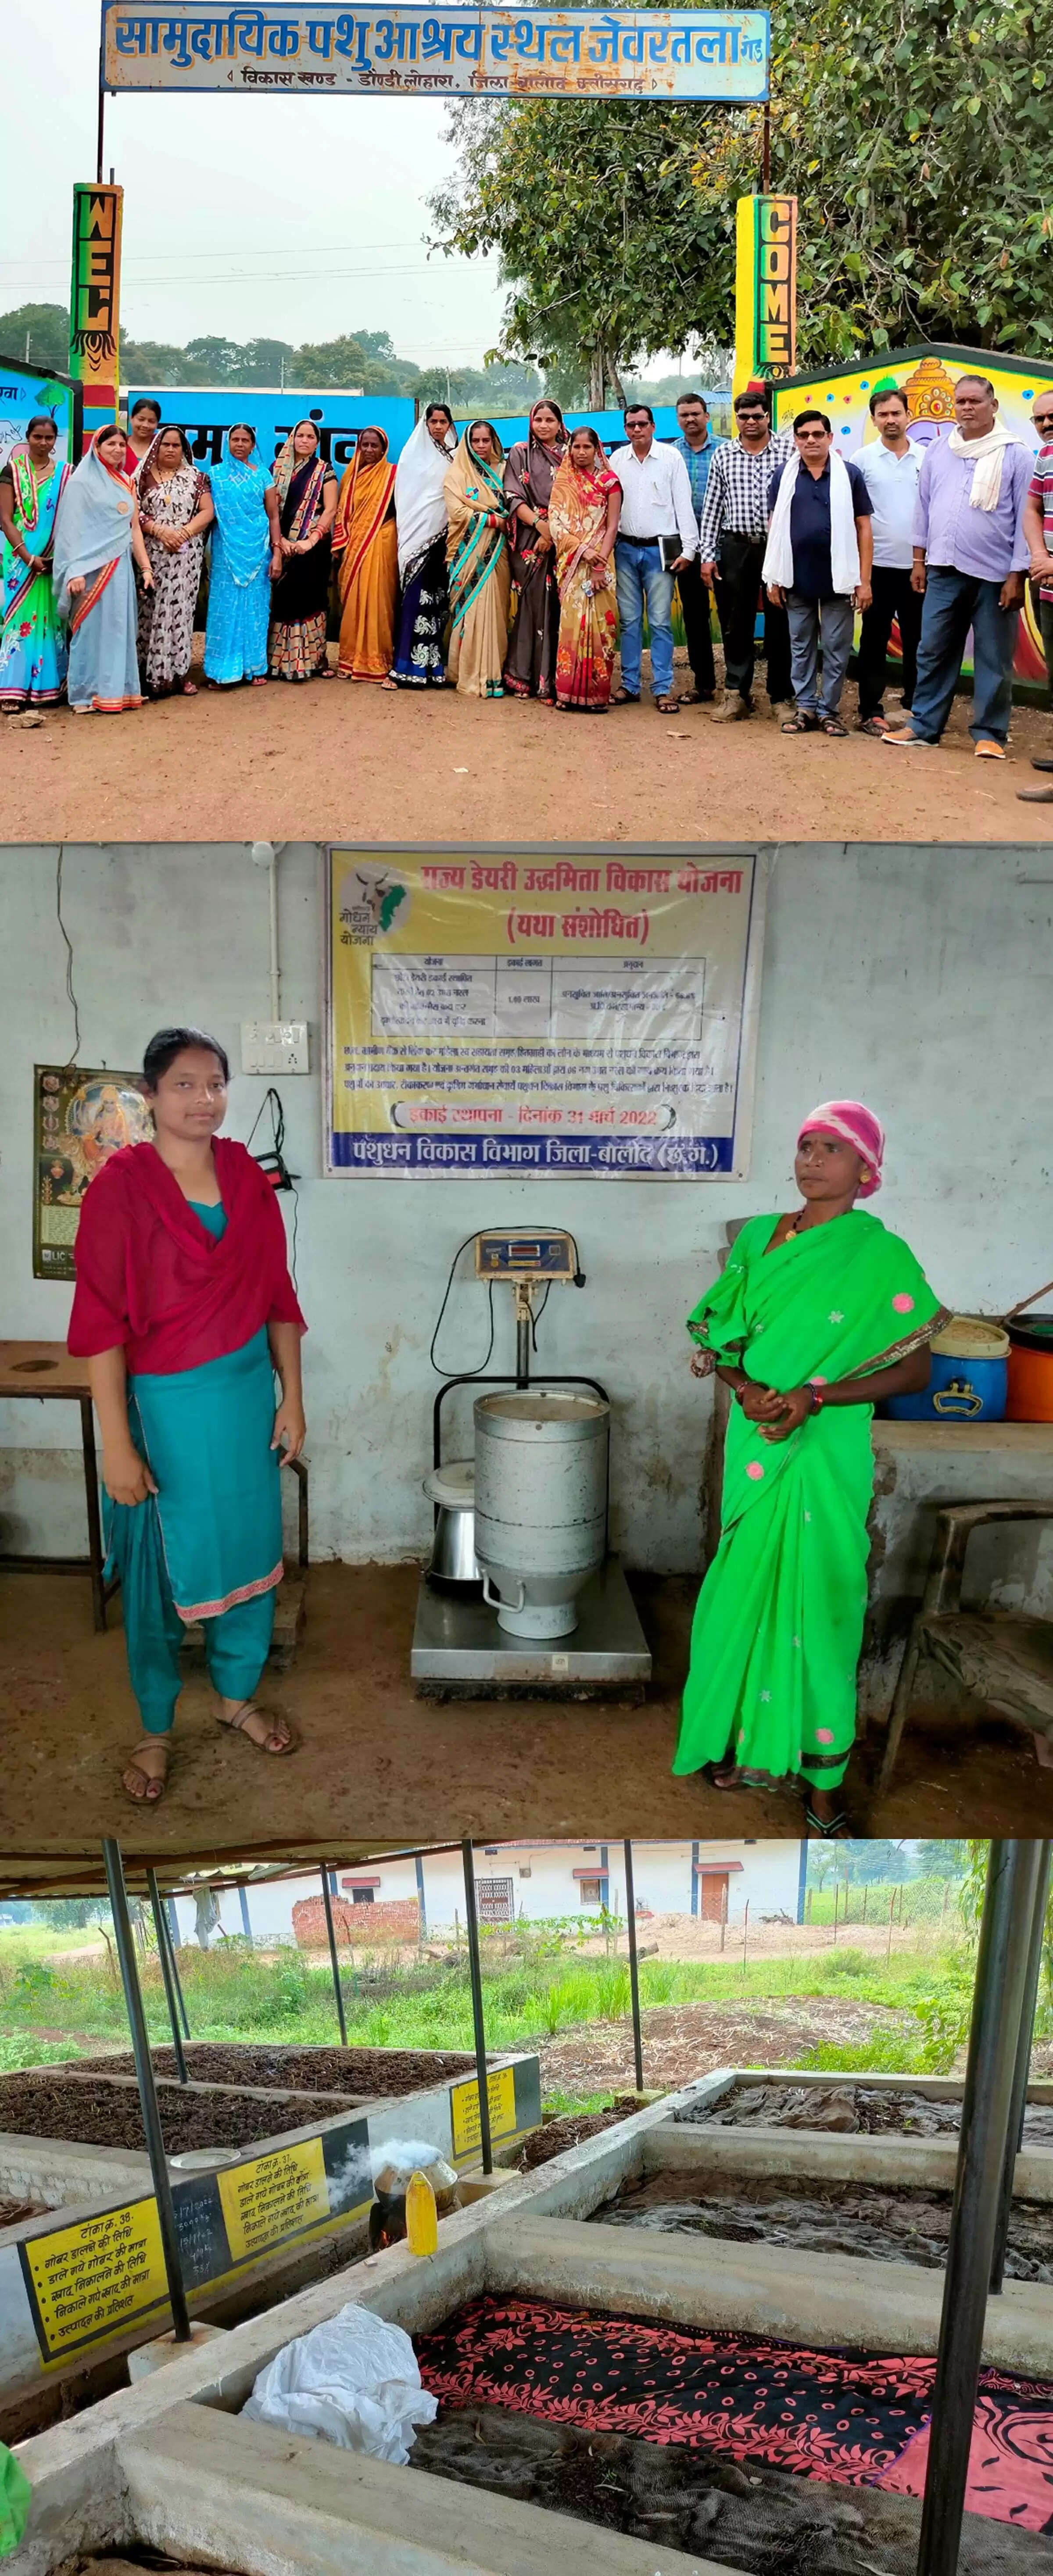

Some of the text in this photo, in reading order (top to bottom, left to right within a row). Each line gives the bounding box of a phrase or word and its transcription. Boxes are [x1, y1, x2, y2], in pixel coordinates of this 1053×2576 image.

[116, 10, 299, 67] सामुदायिक
[306, 14, 372, 71] पशु
[375, 18, 484, 62] आश्रय
[492, 19, 585, 62] स्थल
[241, 66, 295, 86] विकास
[297, 72, 337, 85] खण्ड
[468, 71, 509, 89] जिला
[760, 203, 790, 364] COME
[469, 860, 518, 891] डेयरी
[605, 862, 672, 893] विकास
[677, 861, 744, 893] योजना
[339, 909, 370, 923] गोधन
[507, 906, 649, 945] (यथा संशोधित)
[340, 931, 374, 945] योजना
[567, 1110, 583, 1124] 31
[619, 1111, 657, 1125] 2022
[353, 1140, 411, 1165] पशुधन
[416, 1137, 477, 1161] विकास
[483, 1138, 541, 1163] विभाग
[45, 2226, 133, 2269] गोबर डालने की तिथि
[81, 2222, 105, 2239] टांका
[48, 2238, 147, 2285] डाले गये गोबर की मात्रा
[51, 2251, 147, 2301] खाद निकालने की तिथि
[54, 2269, 150, 2319] निकाले गये खाद की मात्रा
[58, 2294, 134, 2337] उत्पादन की प्रतिशत
